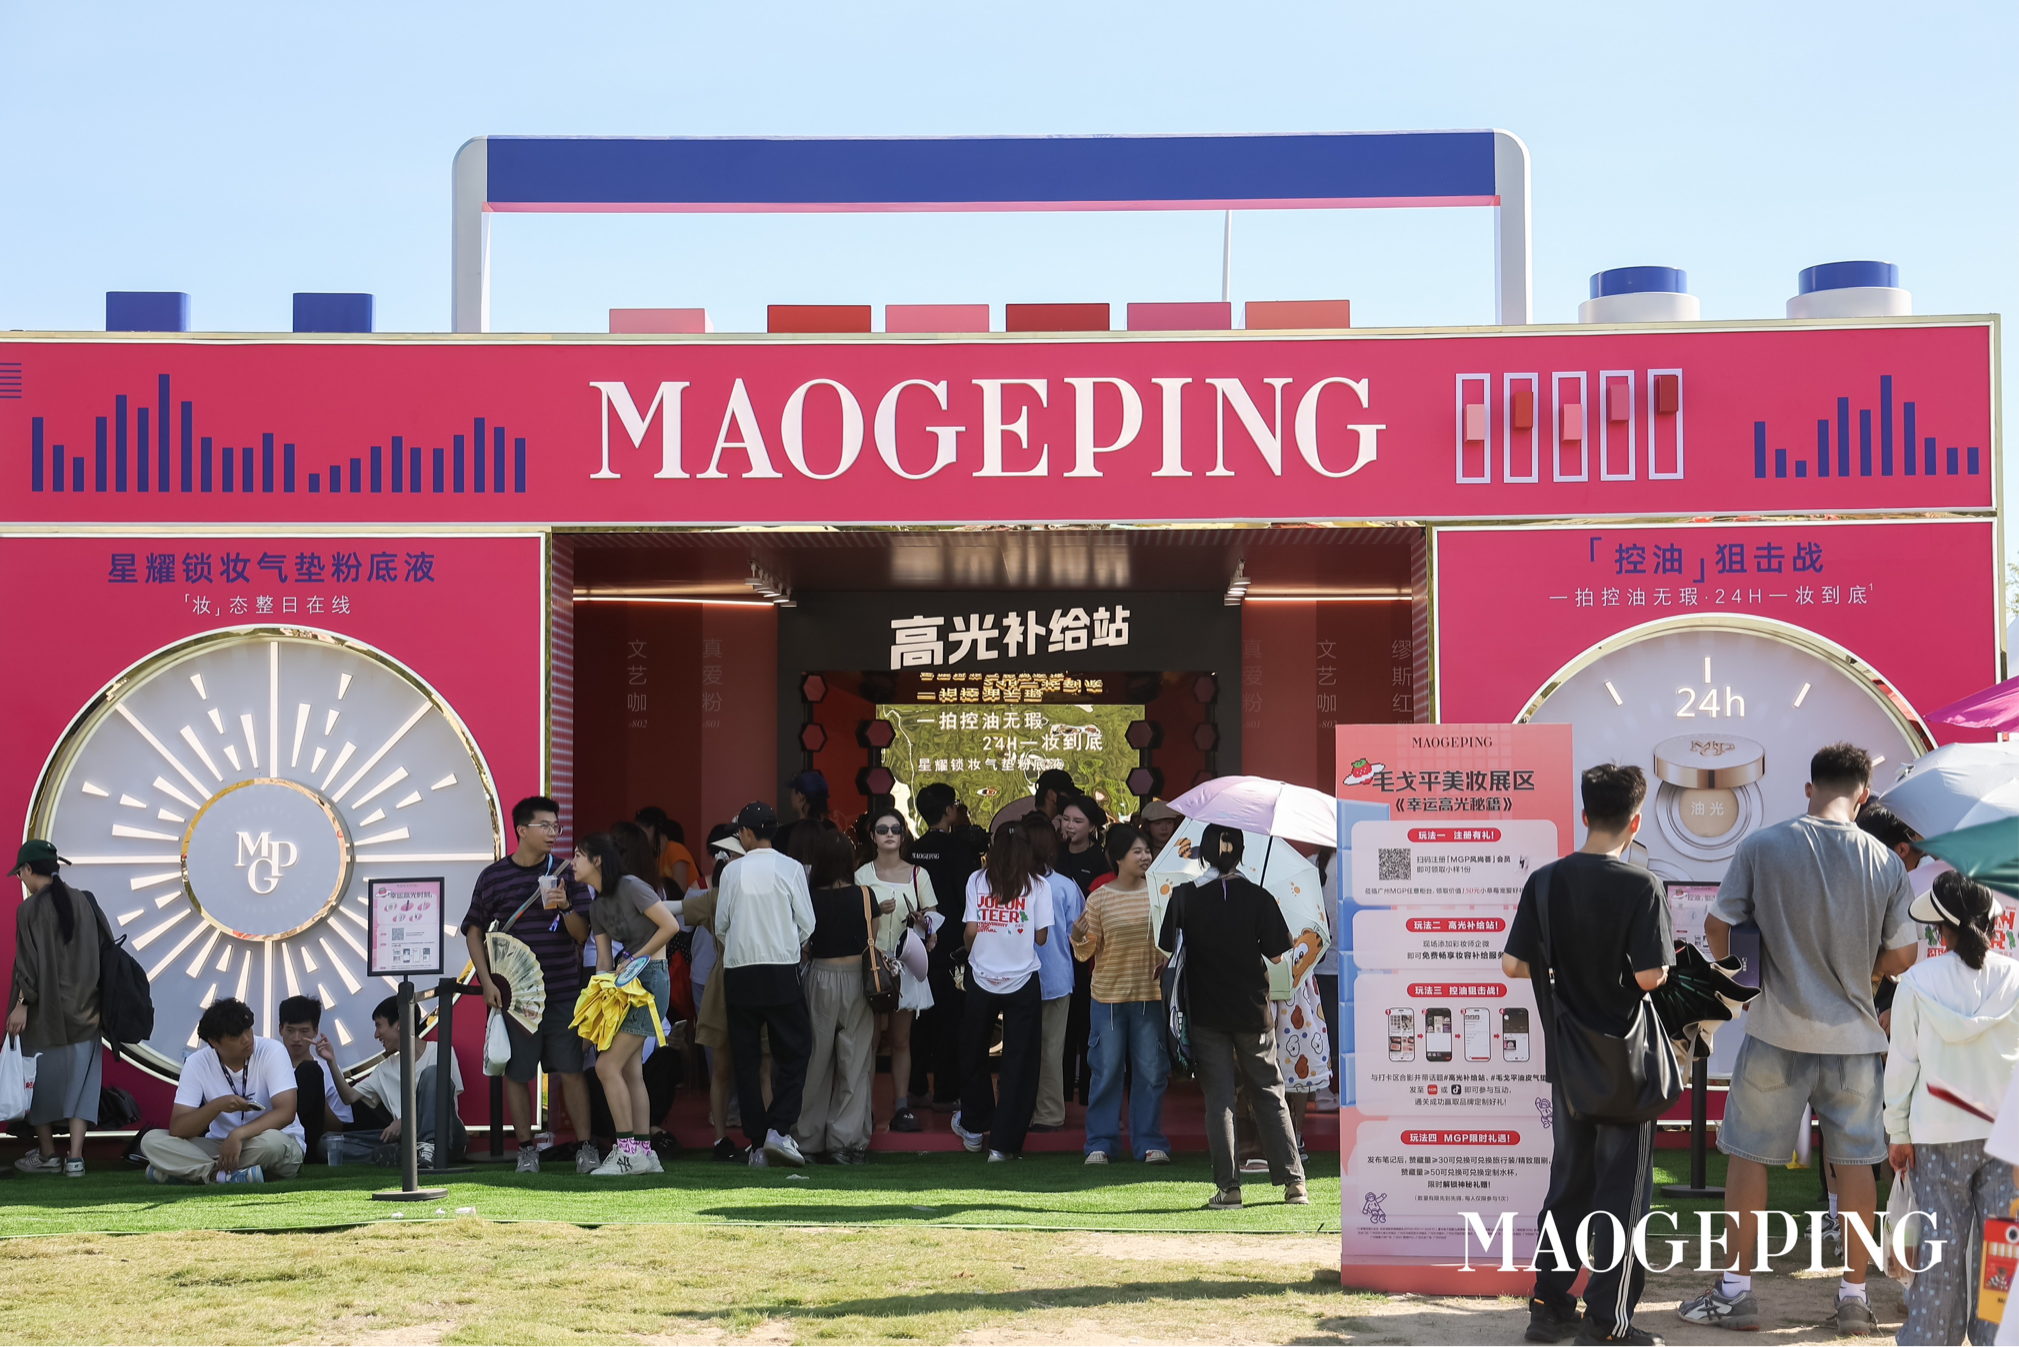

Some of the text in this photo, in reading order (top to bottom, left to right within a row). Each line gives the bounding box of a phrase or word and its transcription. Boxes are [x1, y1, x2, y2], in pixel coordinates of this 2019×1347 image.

[589, 377, 1387, 481] MAOGEPING
[107, 550, 437, 585] 星耀锁妆气垫粉底液
[1589, 536, 1824, 584] 「控油」狙击战
[183, 593, 351, 617] 「妆」态整日在线
[889, 604, 1131, 670] 高光补给站
[626, 639, 648, 713] 文艺咖
[702, 639, 723, 713] 真爱粉
[1243, 640, 1264, 713] 真爱粉
[1316, 639, 1338, 713] 文艺咖
[1391, 639, 1413, 713] 缪斯红
[1675, 686, 1746, 719] 24h
[917, 712, 1043, 731] 一拍控油无瑕
[982, 733, 1103, 752] 24H一妆到底
[1412, 736, 1493, 748] MAOGEPING
[1372, 770, 1535, 793] 毛戈平美妆展区
[1395, 797, 1513, 812] 《幸运高光秘籍》
[1691, 801, 1725, 816] 油光
[1418, 830, 1495, 841] 玩法一 注册有礼！
[979, 908, 1020, 923] TEER
[1414, 920, 1498, 931] 玩法二 高光补给站！
[1422, 939, 1490, 948] 现场添加彩妆师企微
[1415, 985, 1499, 996] 玩法三 控油狙击战！
[1409, 1085, 1424, 1094] 发至
[1440, 1085, 1448, 1094] 或
[1409, 1133, 1511, 1143] 玩法四 MGP限时礼遇！
